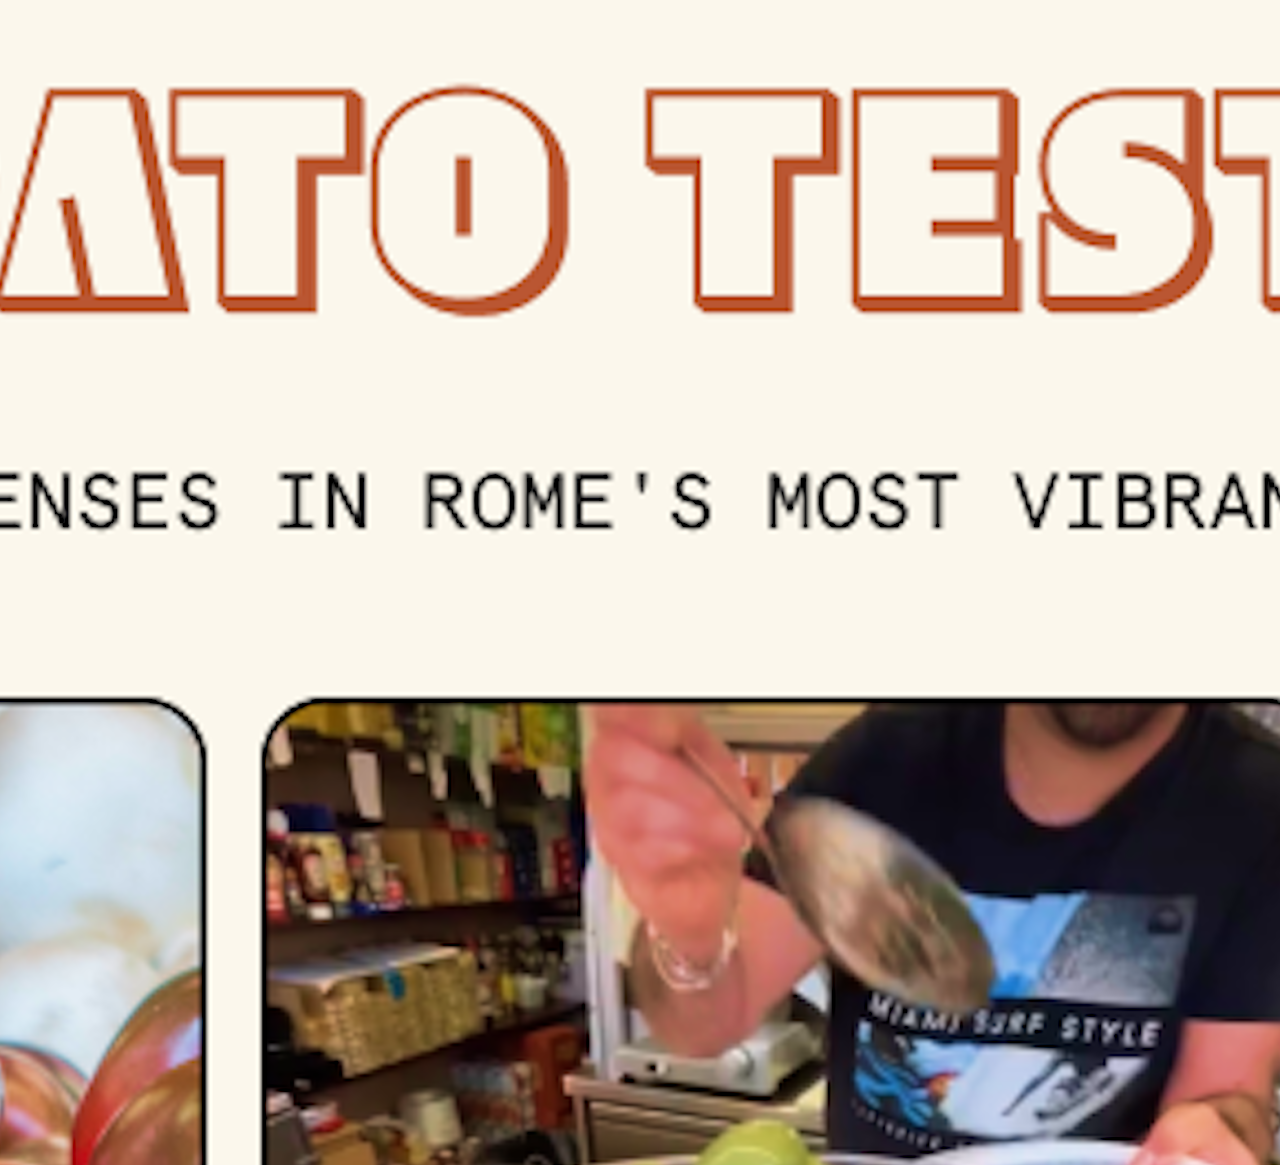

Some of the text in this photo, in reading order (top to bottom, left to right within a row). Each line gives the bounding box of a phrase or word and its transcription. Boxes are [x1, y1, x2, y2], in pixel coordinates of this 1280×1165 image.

[868, 991, 1162, 1048] MIAMI SURF STYLE
